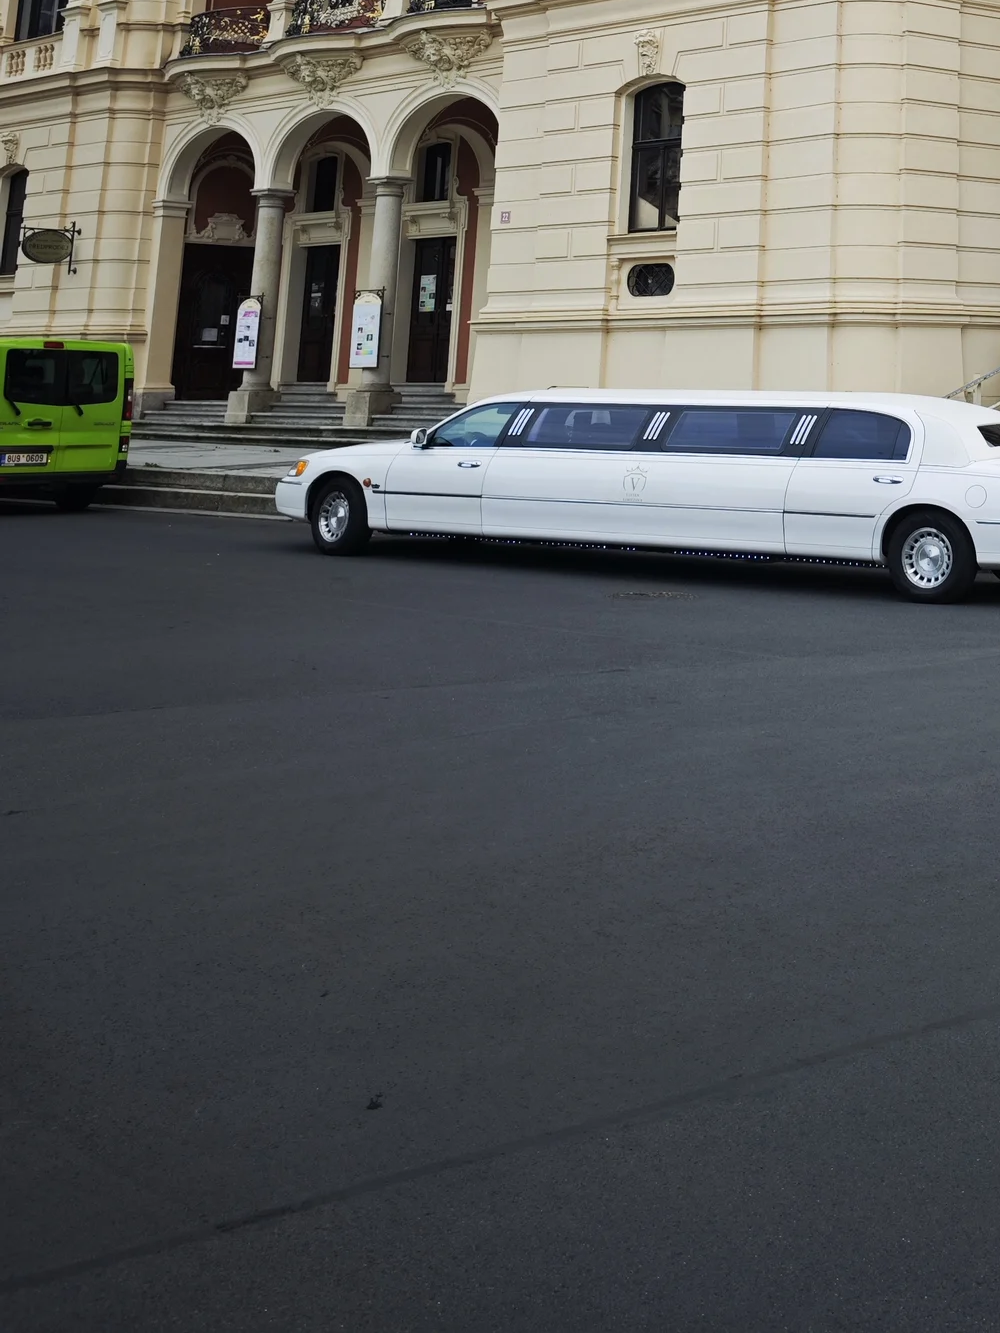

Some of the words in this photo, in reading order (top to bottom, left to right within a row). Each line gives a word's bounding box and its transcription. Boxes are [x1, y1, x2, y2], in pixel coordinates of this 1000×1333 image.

[502, 213, 509, 221] 22
[7, 454, 20, 463] 8U9
[26, 454, 44, 463] 0609
[631, 477, 640, 491] V
